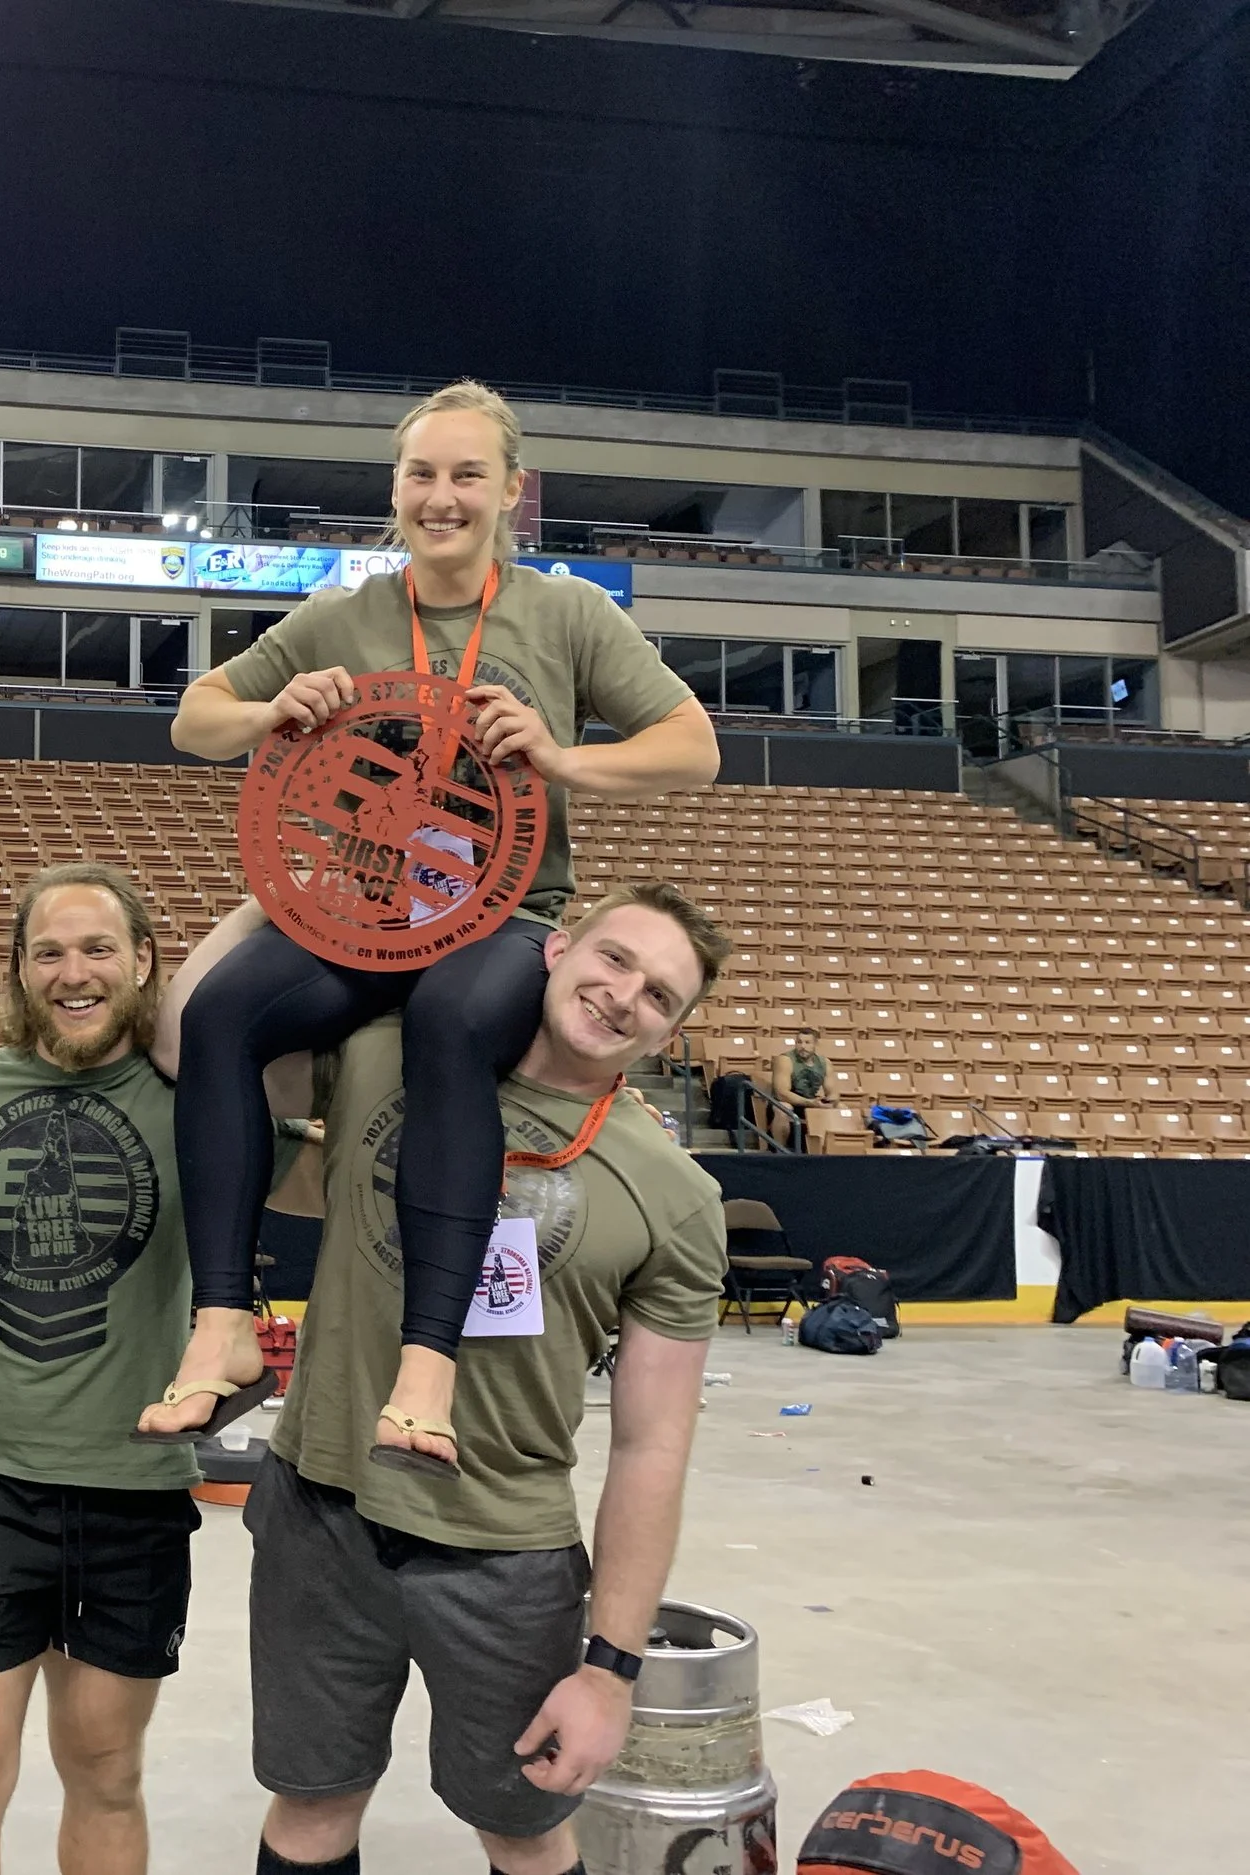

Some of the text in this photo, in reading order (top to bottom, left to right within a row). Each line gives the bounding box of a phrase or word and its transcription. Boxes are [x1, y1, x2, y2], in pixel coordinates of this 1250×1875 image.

[41, 542, 60, 552] Keep
[62, 543, 78, 551] kids
[41, 551, 59, 560] Stop
[96, 554, 127, 565] drinking
[208, 553, 243, 573] E&R
[336, 830, 408, 880] FIRST
[481, 807, 536, 915] NATIONALS
[320, 868, 399, 908] PLACE
[376, 943, 432, 961] Women's
[433, 932, 456, 952] MW
[361, 1109, 394, 1149] 2022
[8, 1093, 56, 1121] STATES
[68, 1094, 139, 1159] STRONGMAN
[126, 1156, 154, 1242] NATIONALS
[23, 1193, 73, 1220] LIVE
[26, 1218, 75, 1243] FREE
[30, 1239, 77, 1257] OR DIE
[500, 1246, 528, 1268] STRONGMAN
[2, 1257, 119, 1293] ARSENAL ATHLETICS
[821, 1809, 987, 1870] cerberus
